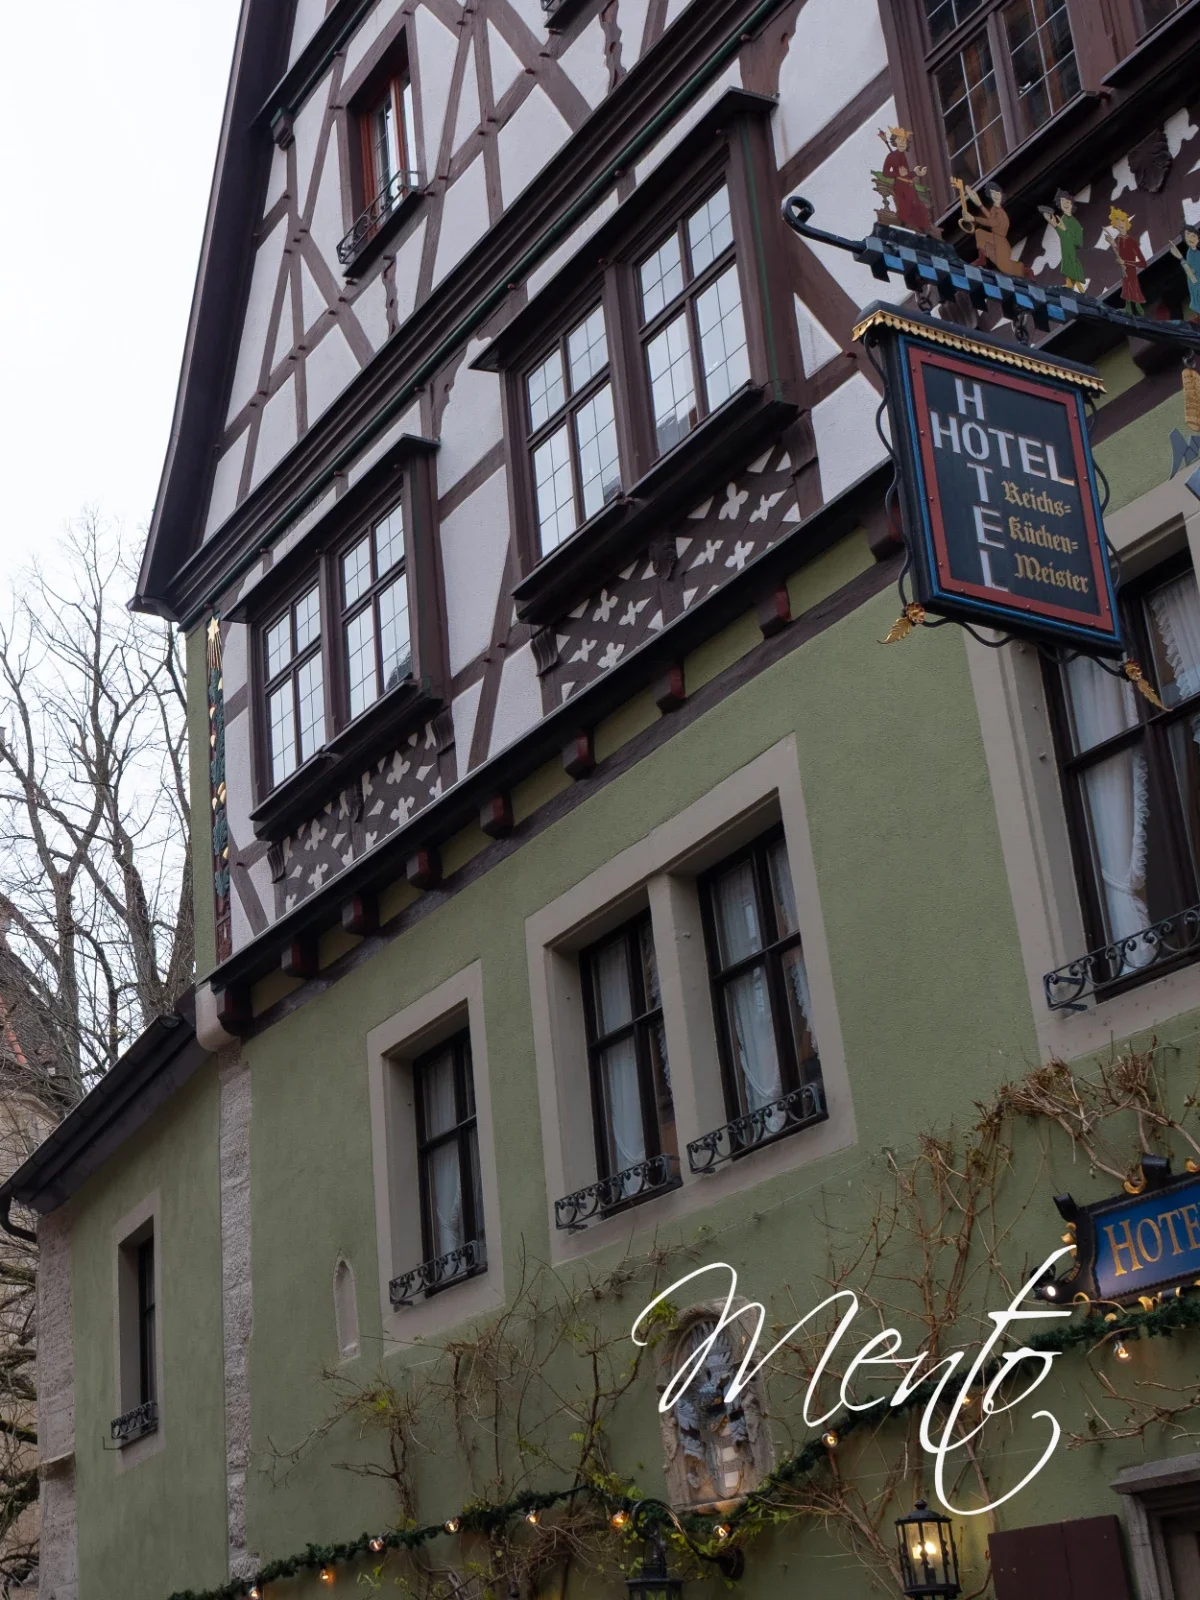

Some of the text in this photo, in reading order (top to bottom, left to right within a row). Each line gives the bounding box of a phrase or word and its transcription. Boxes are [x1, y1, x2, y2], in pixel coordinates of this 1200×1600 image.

[931, 411, 1075, 486] HOTEL
[955, 378, 1008, 591] HOTEL
[1014, 553, 1089, 594] Meister
[1103, 1202, 1200, 1276] HOTE
